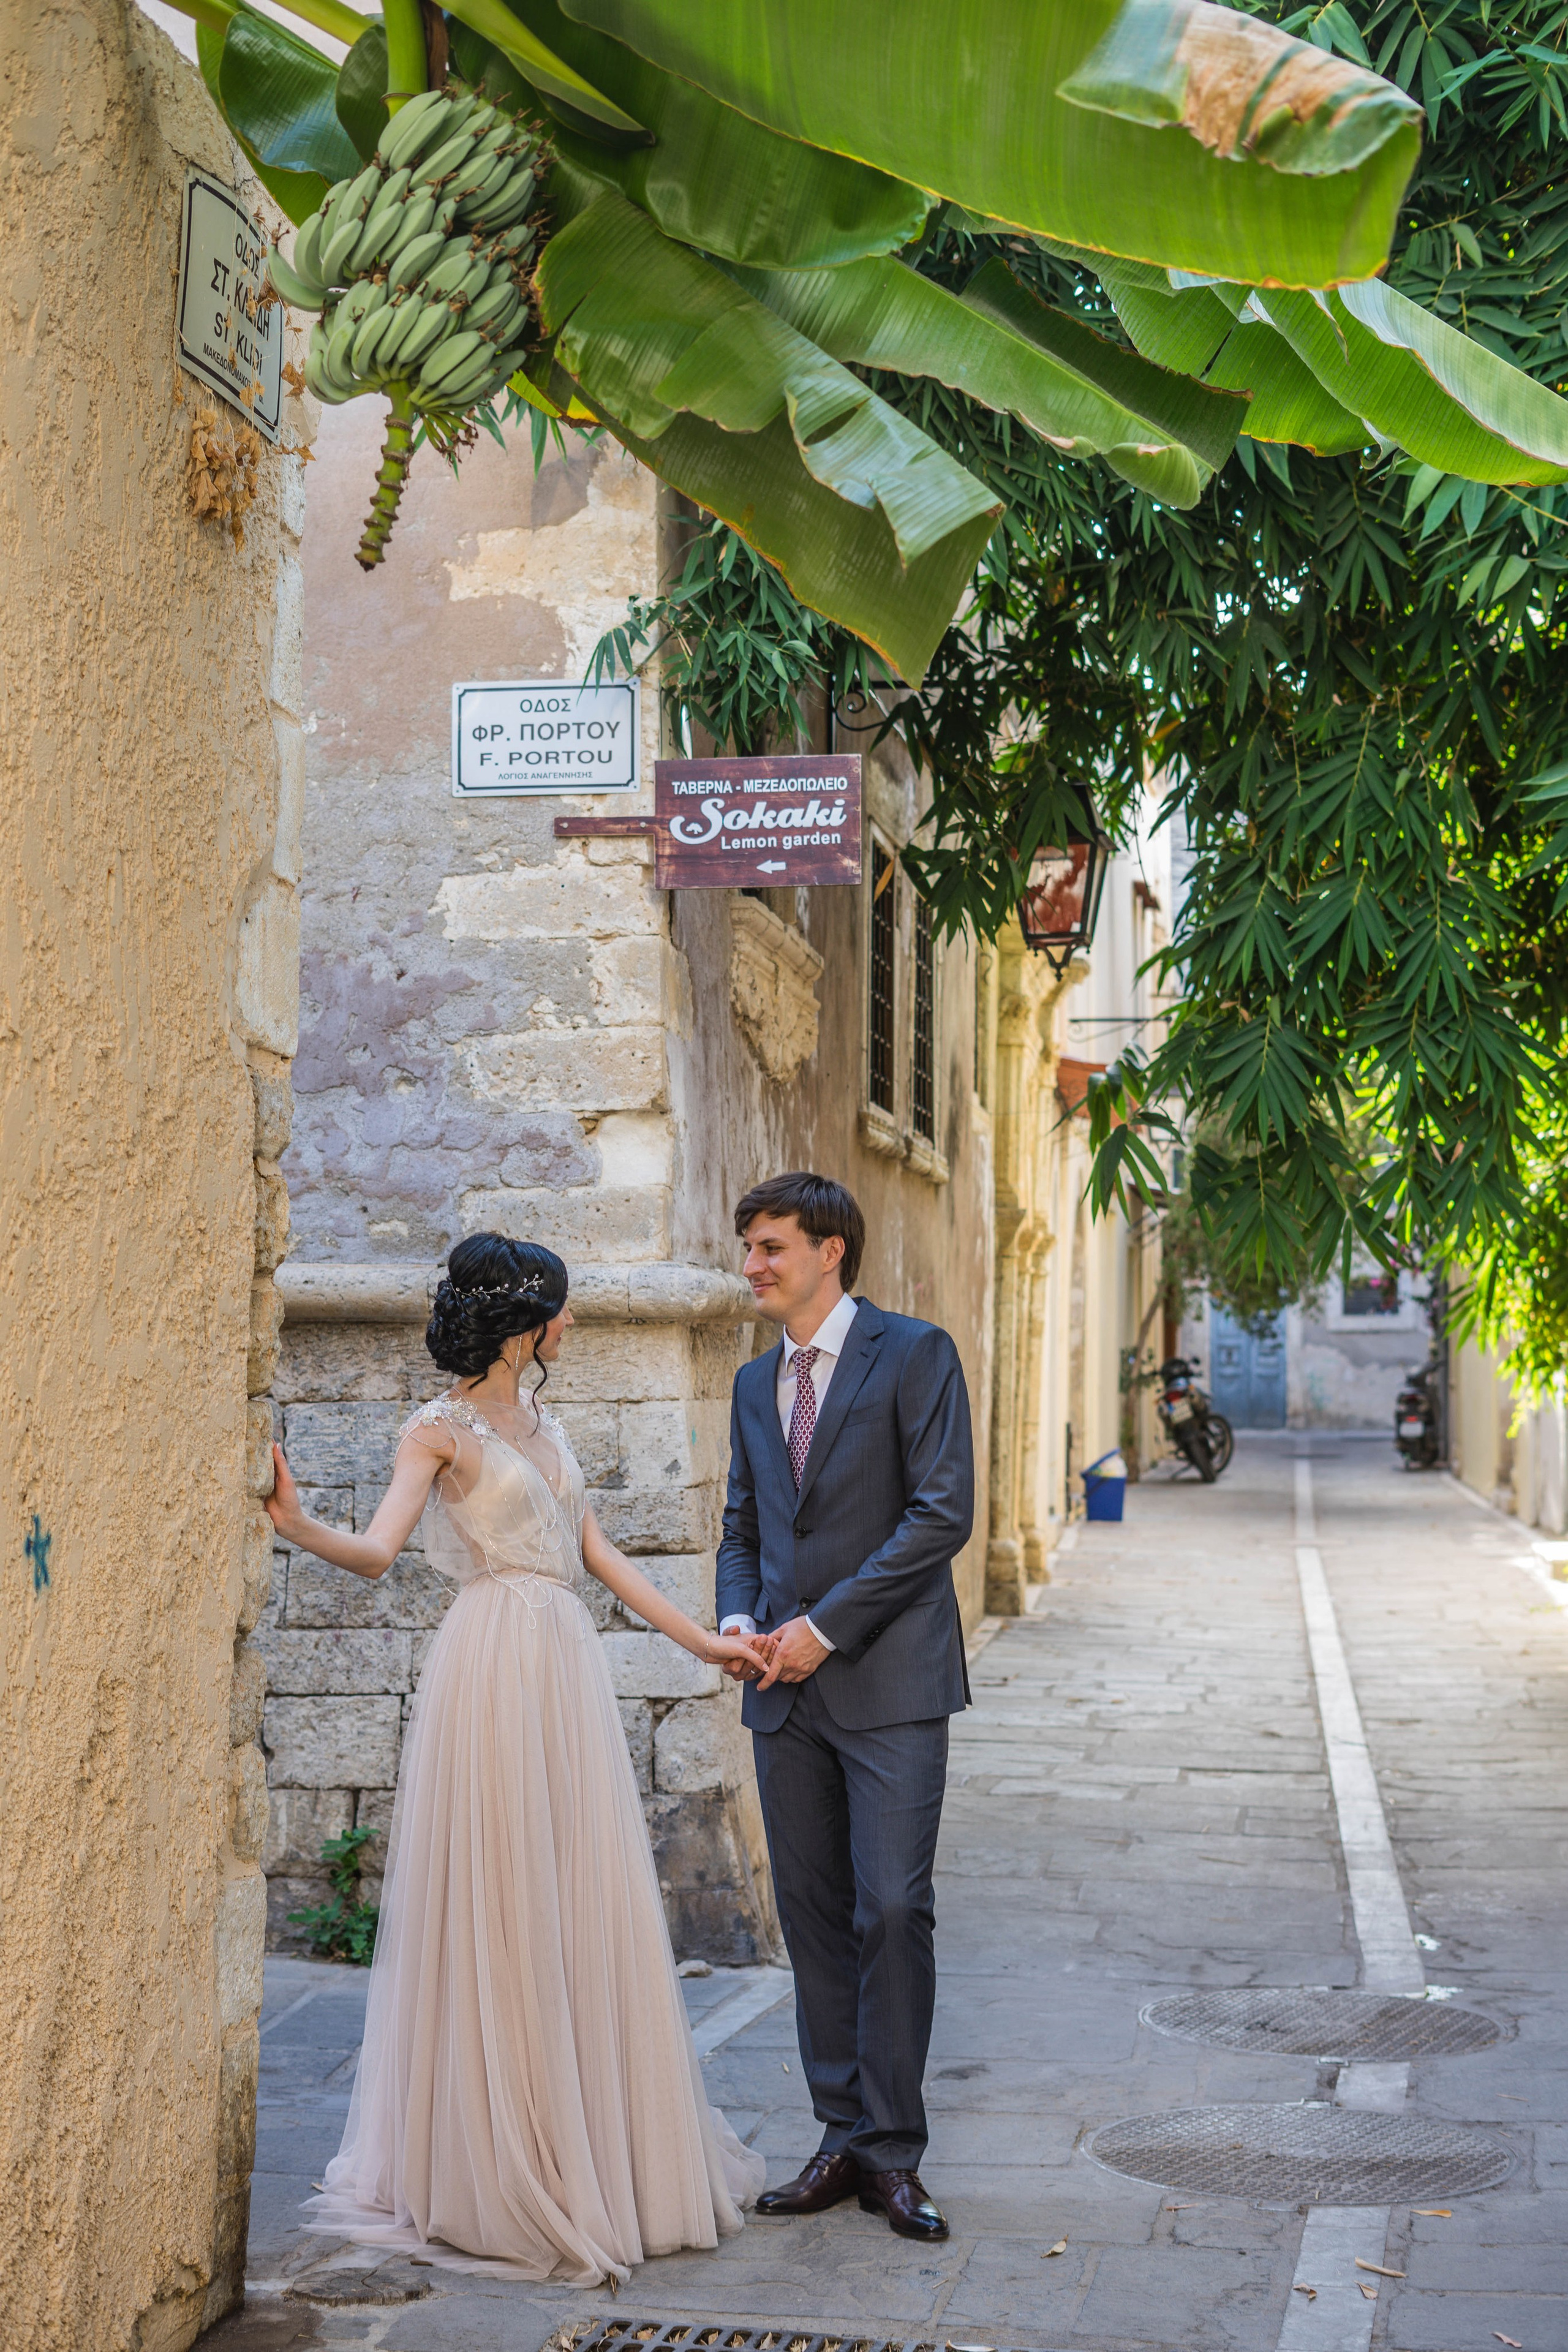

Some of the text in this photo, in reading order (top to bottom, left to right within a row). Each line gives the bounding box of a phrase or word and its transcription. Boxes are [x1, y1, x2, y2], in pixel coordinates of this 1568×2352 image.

[211, 258, 230, 301] ΣΤ.
[520, 698, 571, 713] ΟΔΟΣ
[472, 721, 620, 742] ΦΡ. ΠΟΡΤΟΥ
[480, 750, 612, 766] F. PORTOU
[671, 780, 733, 795] ΤΑΒΕΡΝΑ
[743, 777, 848, 793] ΜΕΖΕΔΟΠΩΛΕΙΟ
[669, 797, 847, 845] Sokaki
[720, 831, 842, 850] Lemon garden
